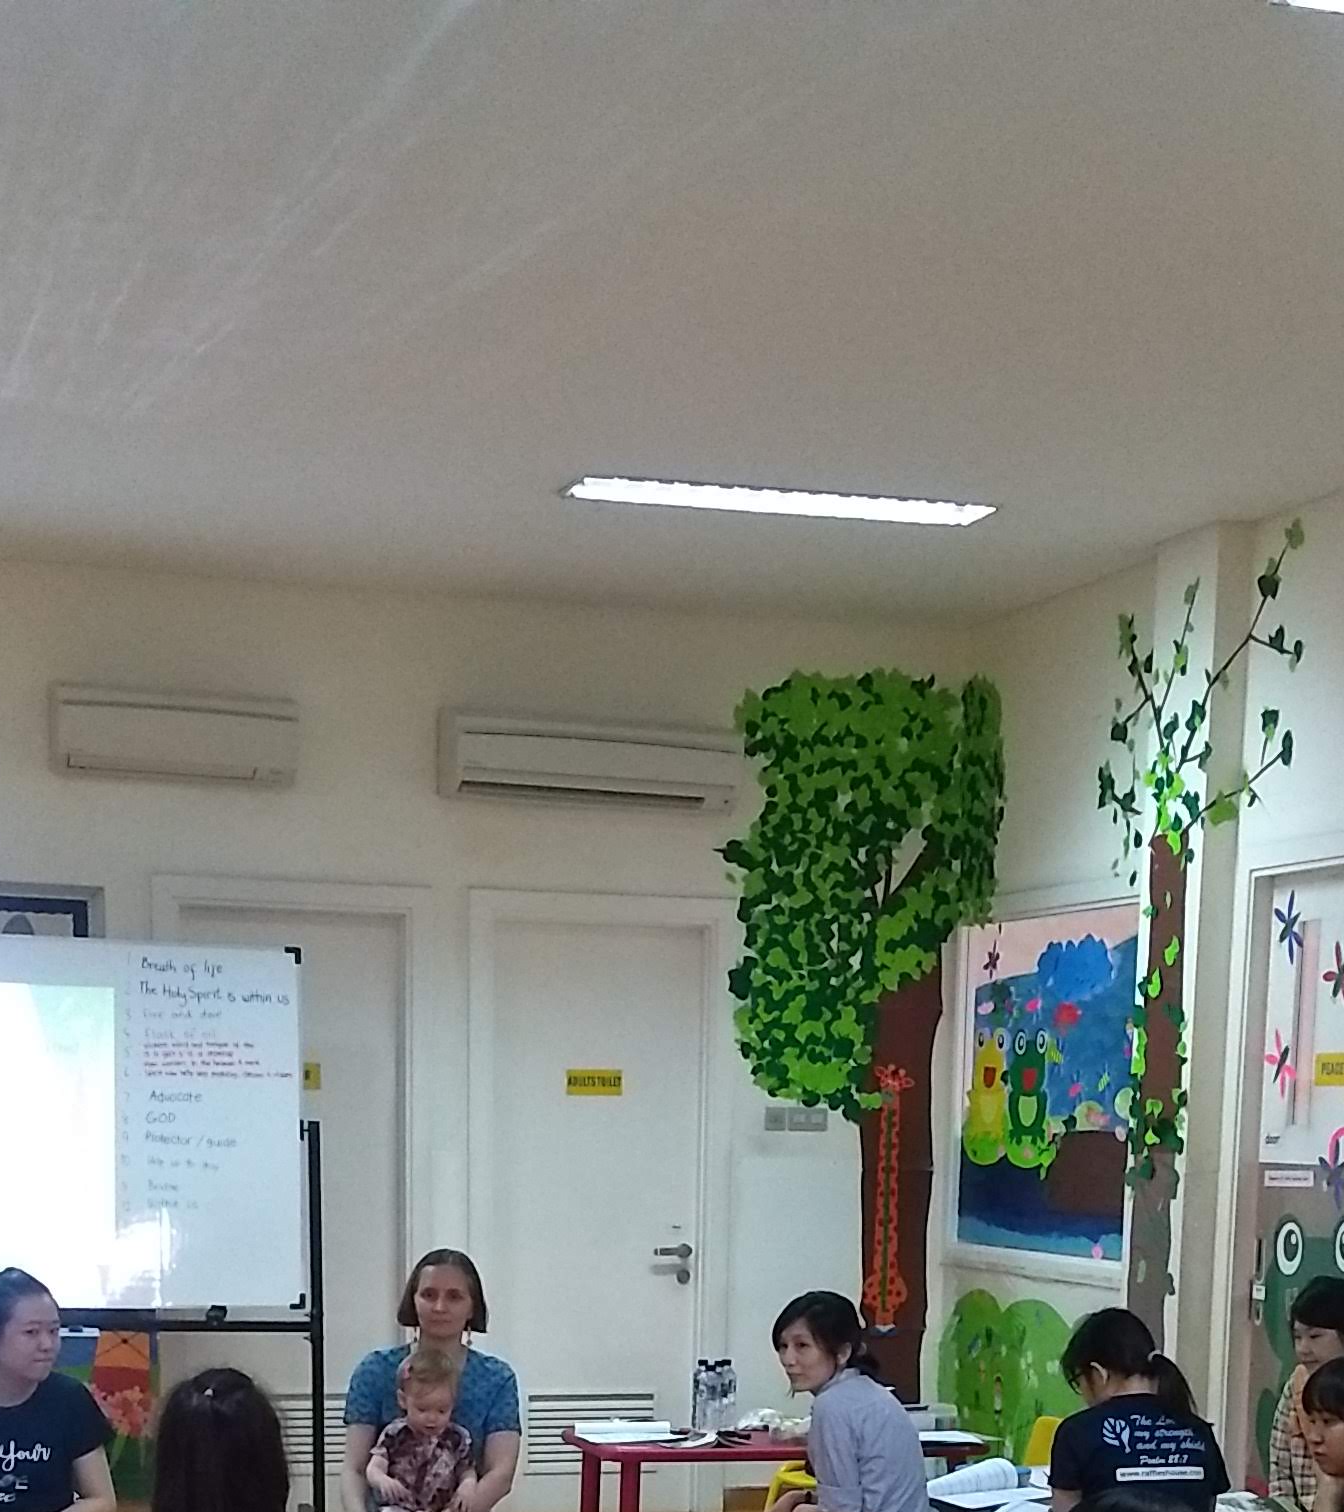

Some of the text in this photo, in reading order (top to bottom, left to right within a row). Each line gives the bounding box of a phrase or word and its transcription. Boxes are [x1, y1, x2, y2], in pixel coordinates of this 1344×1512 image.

[141, 956, 177, 972] Breath
[140, 980, 158, 995] The
[145, 1111, 176, 1124] GOD
[1130, 1414, 1152, 1427] The
